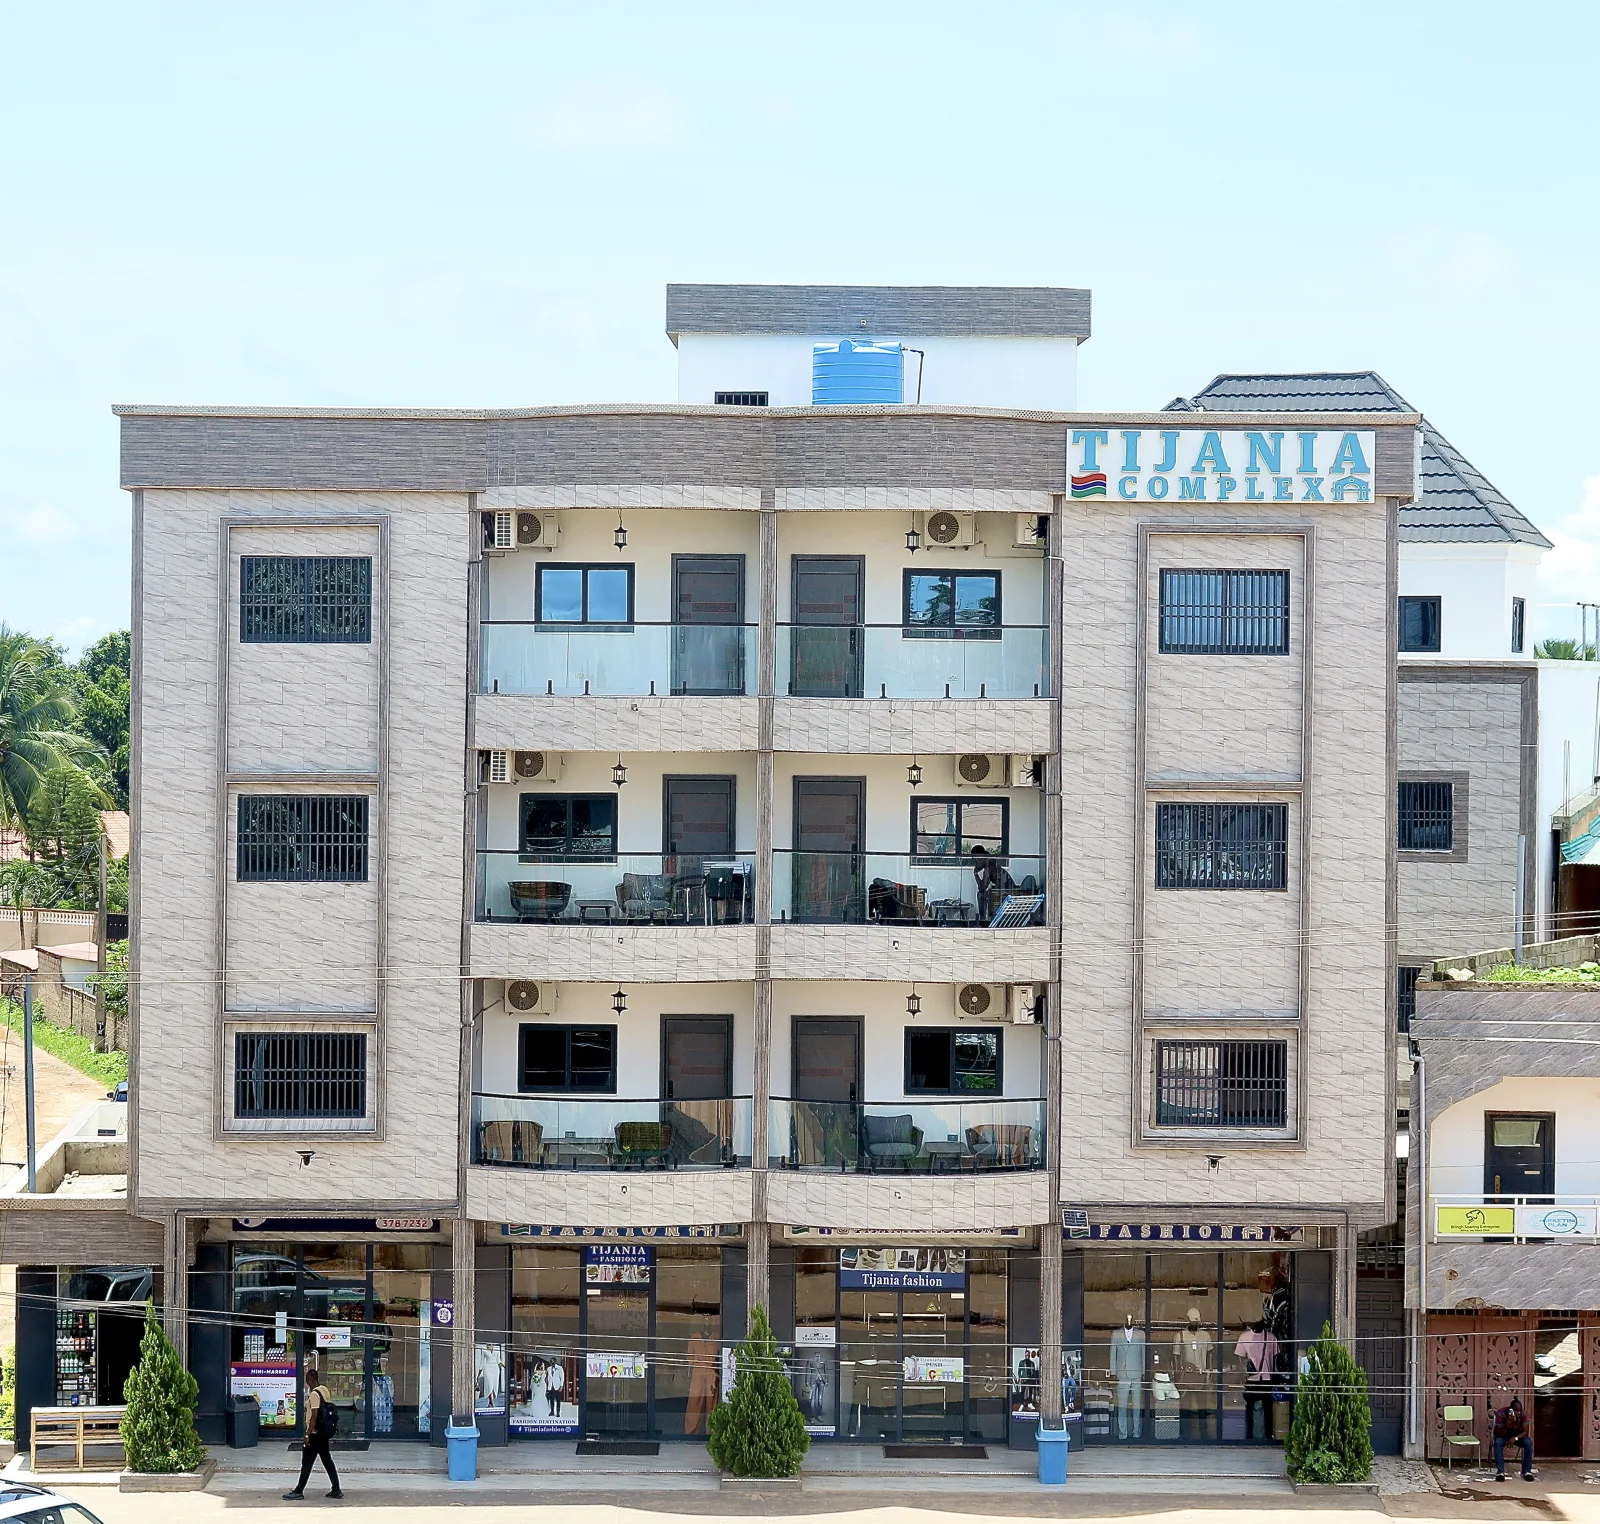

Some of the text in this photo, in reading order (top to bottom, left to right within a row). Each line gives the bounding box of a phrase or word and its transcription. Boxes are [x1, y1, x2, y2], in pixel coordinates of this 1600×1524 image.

[1072, 430, 1370, 474] TIJANIA
[1118, 476, 1324, 500] COMPLEX
[1100, 1225, 1234, 1239] FASHION
[590, 1246, 646, 1254] TIJANIA
[862, 1273, 943, 1287] Tijania fashion
